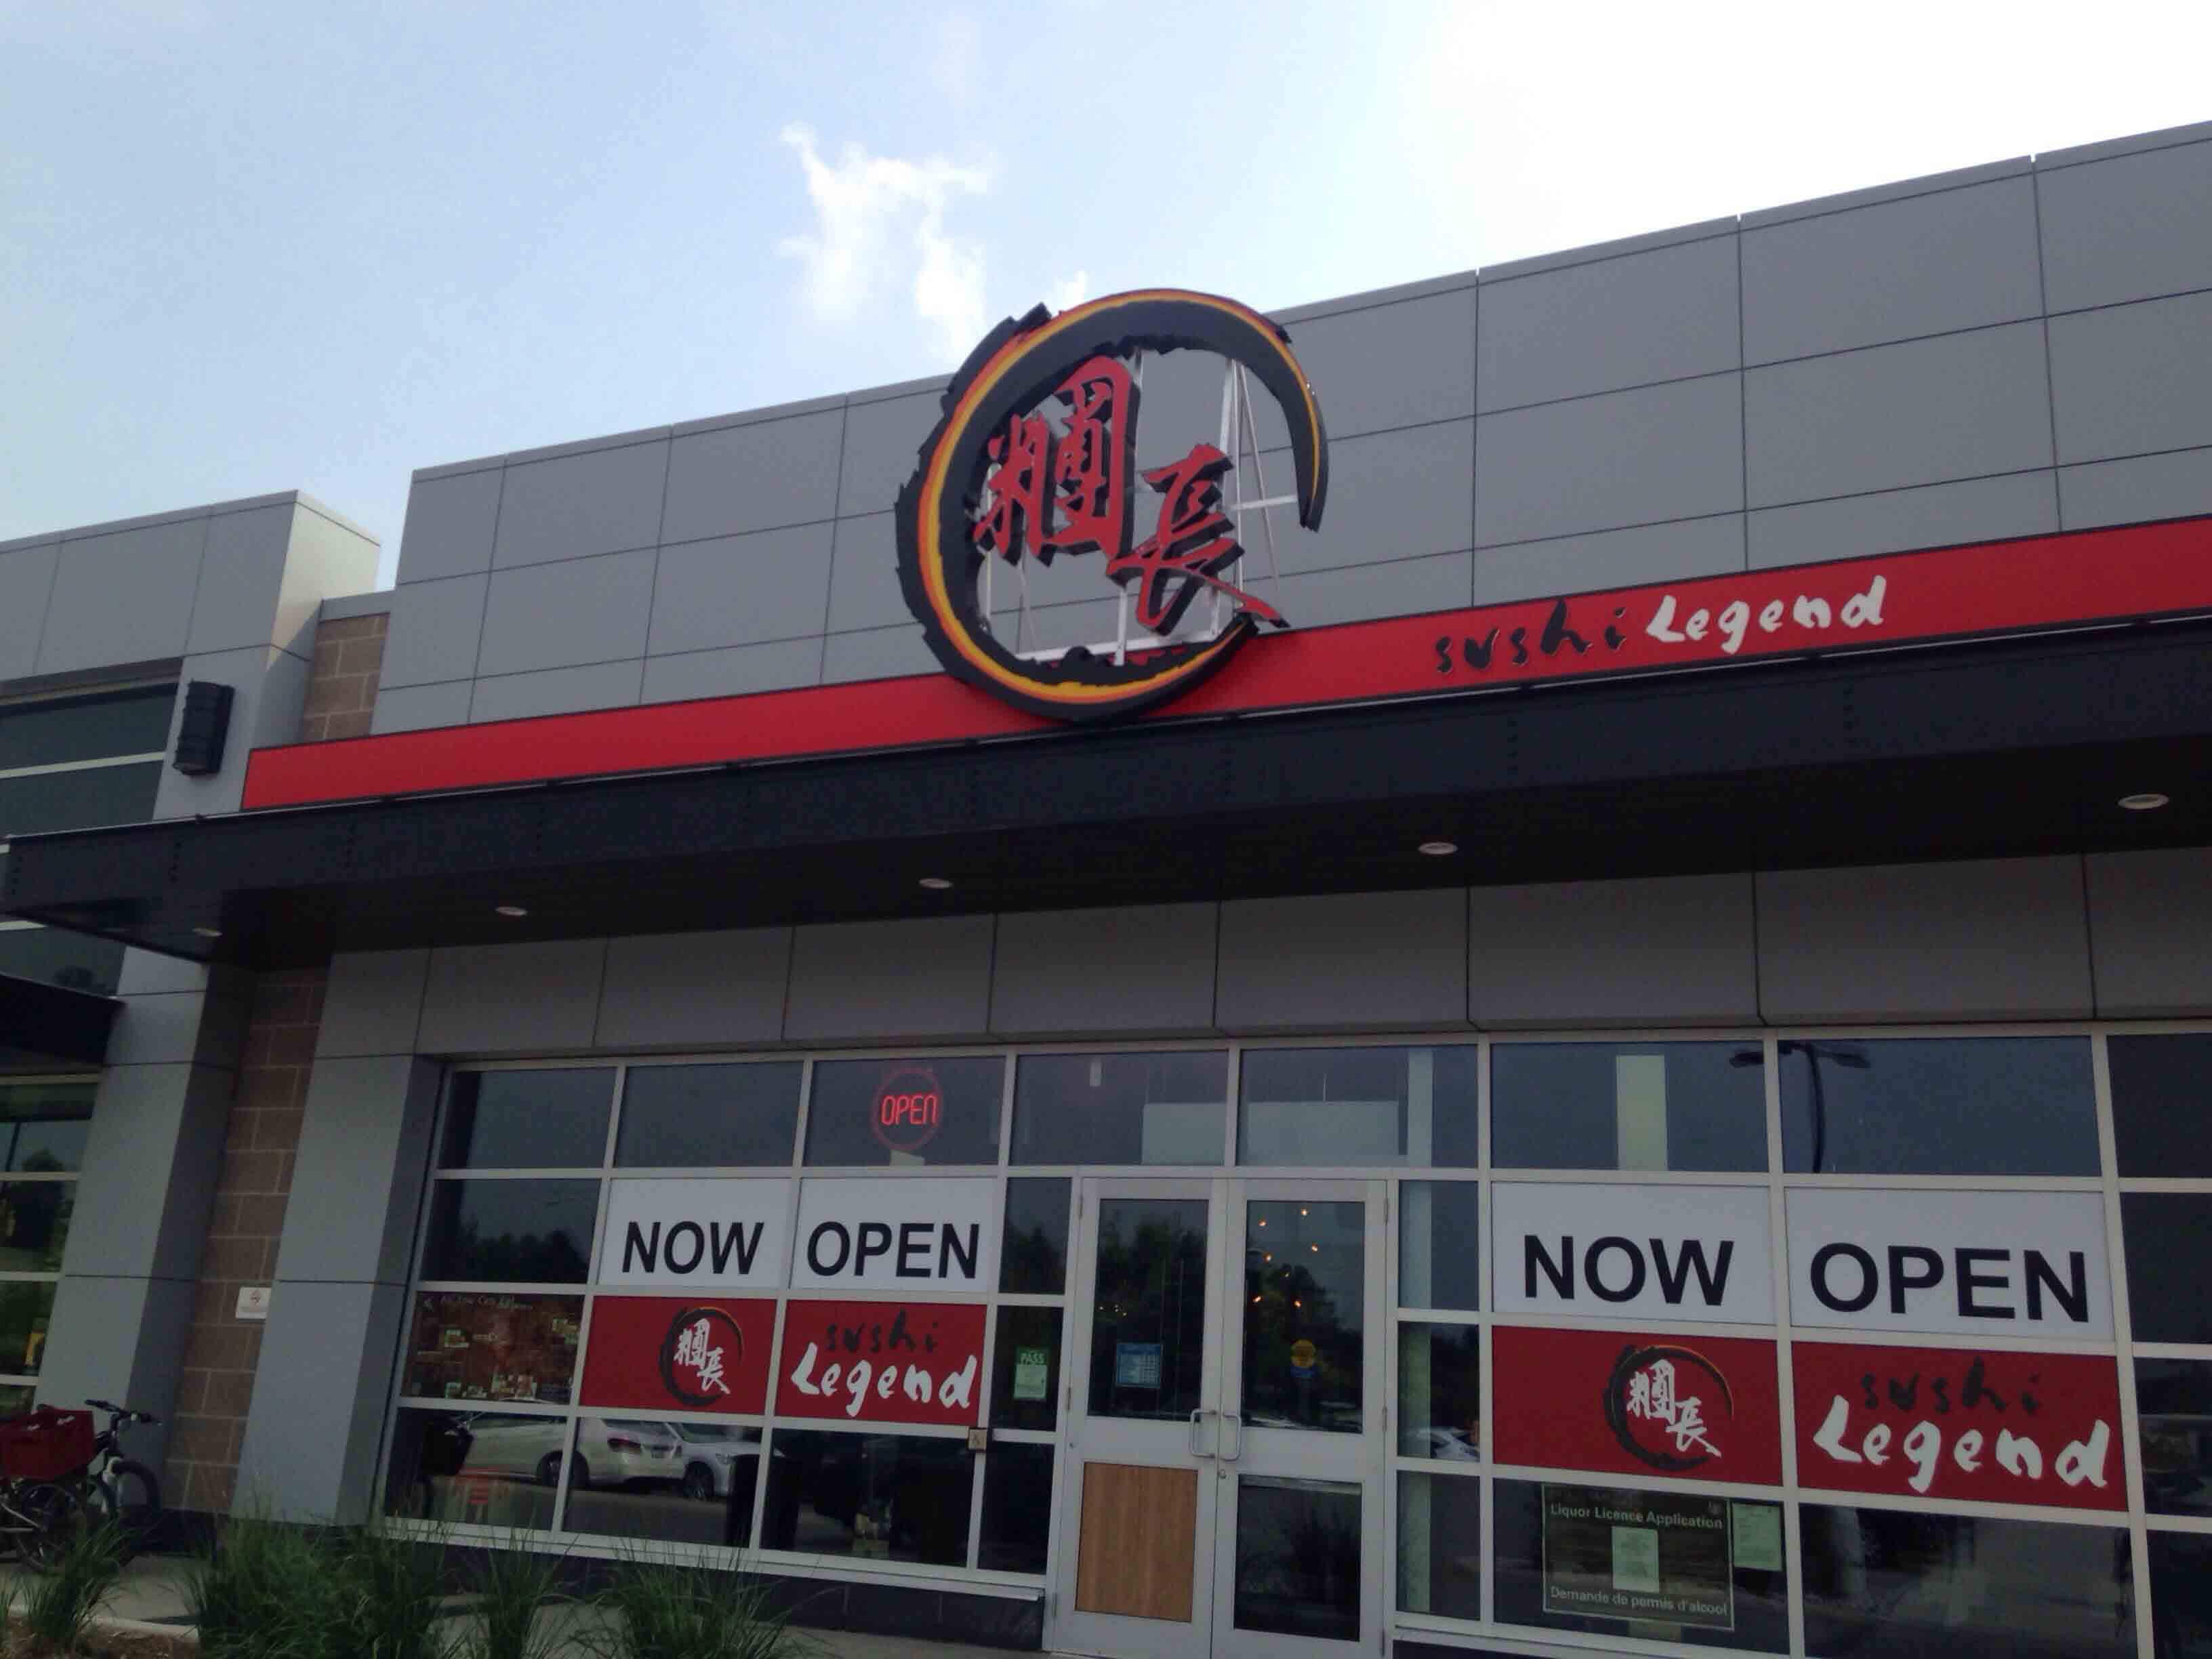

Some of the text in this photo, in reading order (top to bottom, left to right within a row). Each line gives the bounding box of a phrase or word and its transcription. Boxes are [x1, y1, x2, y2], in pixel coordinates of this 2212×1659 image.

[1435, 575, 1887, 674] sushi Legend
[882, 1094, 938, 1126] OPEN
[622, 1221, 979, 1279] NOW OPEN
[1524, 1234, 2089, 1324] NOW OPEN
[826, 1308, 938, 1353] sushi
[790, 1341, 978, 1418] Legend
[1860, 1355, 2041, 1416] sushi
[1813, 1395, 2110, 1493] Legend
[1551, 1503, 1723, 1530] Liquor Licence Application
[1551, 1586, 1609, 1604] Demande
[1612, 1591, 1628, 1605] de
